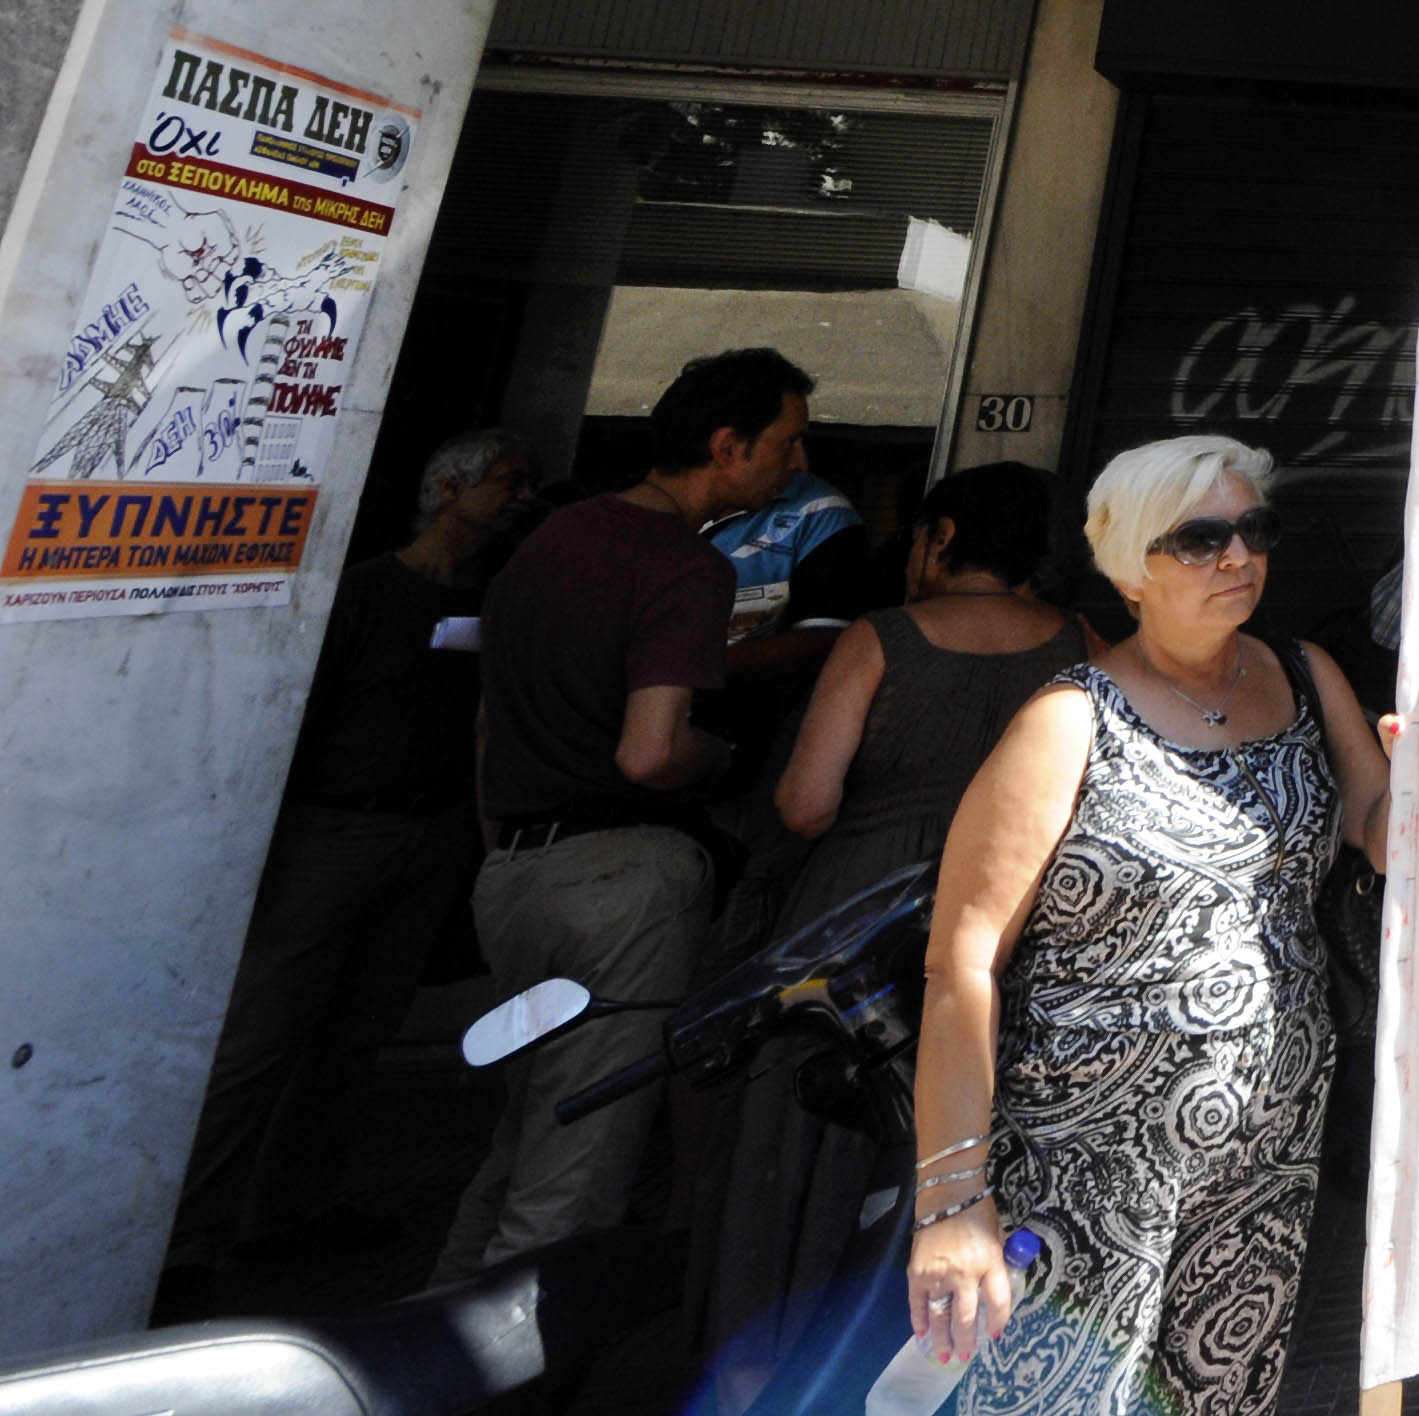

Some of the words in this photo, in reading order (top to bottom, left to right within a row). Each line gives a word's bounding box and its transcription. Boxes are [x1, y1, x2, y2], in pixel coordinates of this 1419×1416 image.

[161, 49, 299, 133] ΠΑΣΠΑ
[303, 95, 374, 154] ΔΕΗ
[167, 161, 289, 206] ΞΕΠΟΥΛΗΜΑ
[313, 197, 360, 224] ΜΙΚΡΗΣ
[360, 210, 386, 230] ΔΕΗ
[978, 395, 1032, 432] 30
[28, 493, 309, 539] ΞΥΠΝΗΣΤΕ
[18, 547, 38, 571] Η
[38, 544, 122, 570] ΜΗΤΕΡΑ
[127, 544, 170, 567] ΤΩΝ
